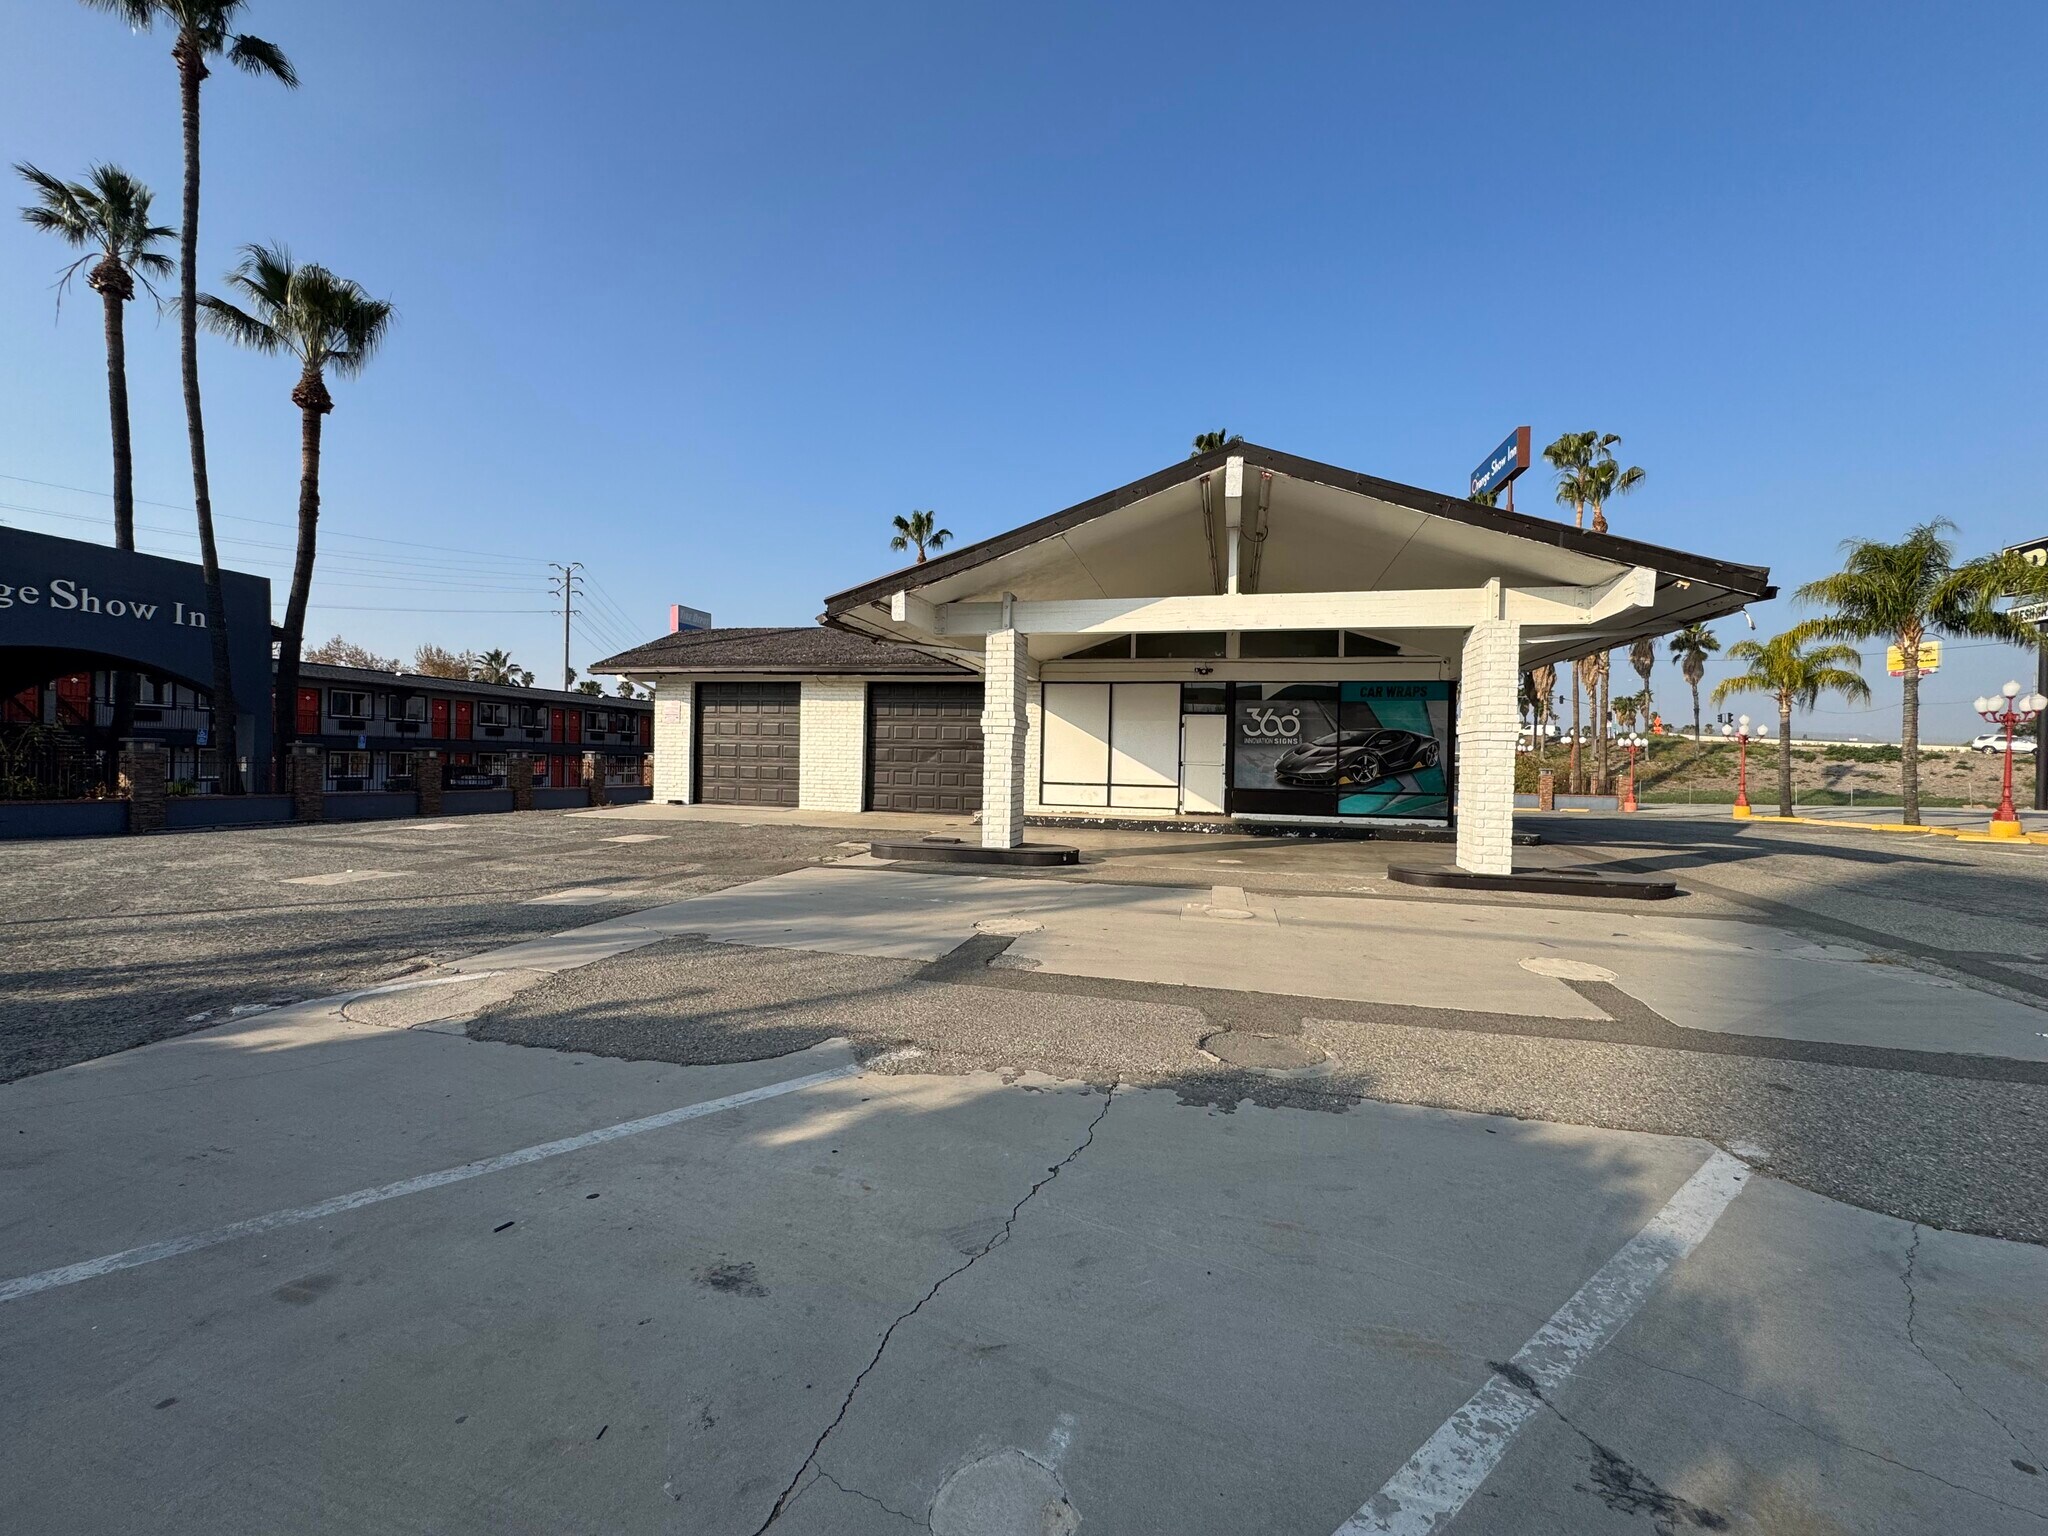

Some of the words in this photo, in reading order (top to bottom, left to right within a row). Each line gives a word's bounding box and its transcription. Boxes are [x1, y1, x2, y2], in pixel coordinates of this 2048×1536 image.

[50, 579, 158, 621] Show
[172, 601, 228, 630] In
[1359, 686, 1384, 698] CAR
[1386, 685, 1428, 698] WRAPS
[1274, 737, 1298, 745] SIGNS
